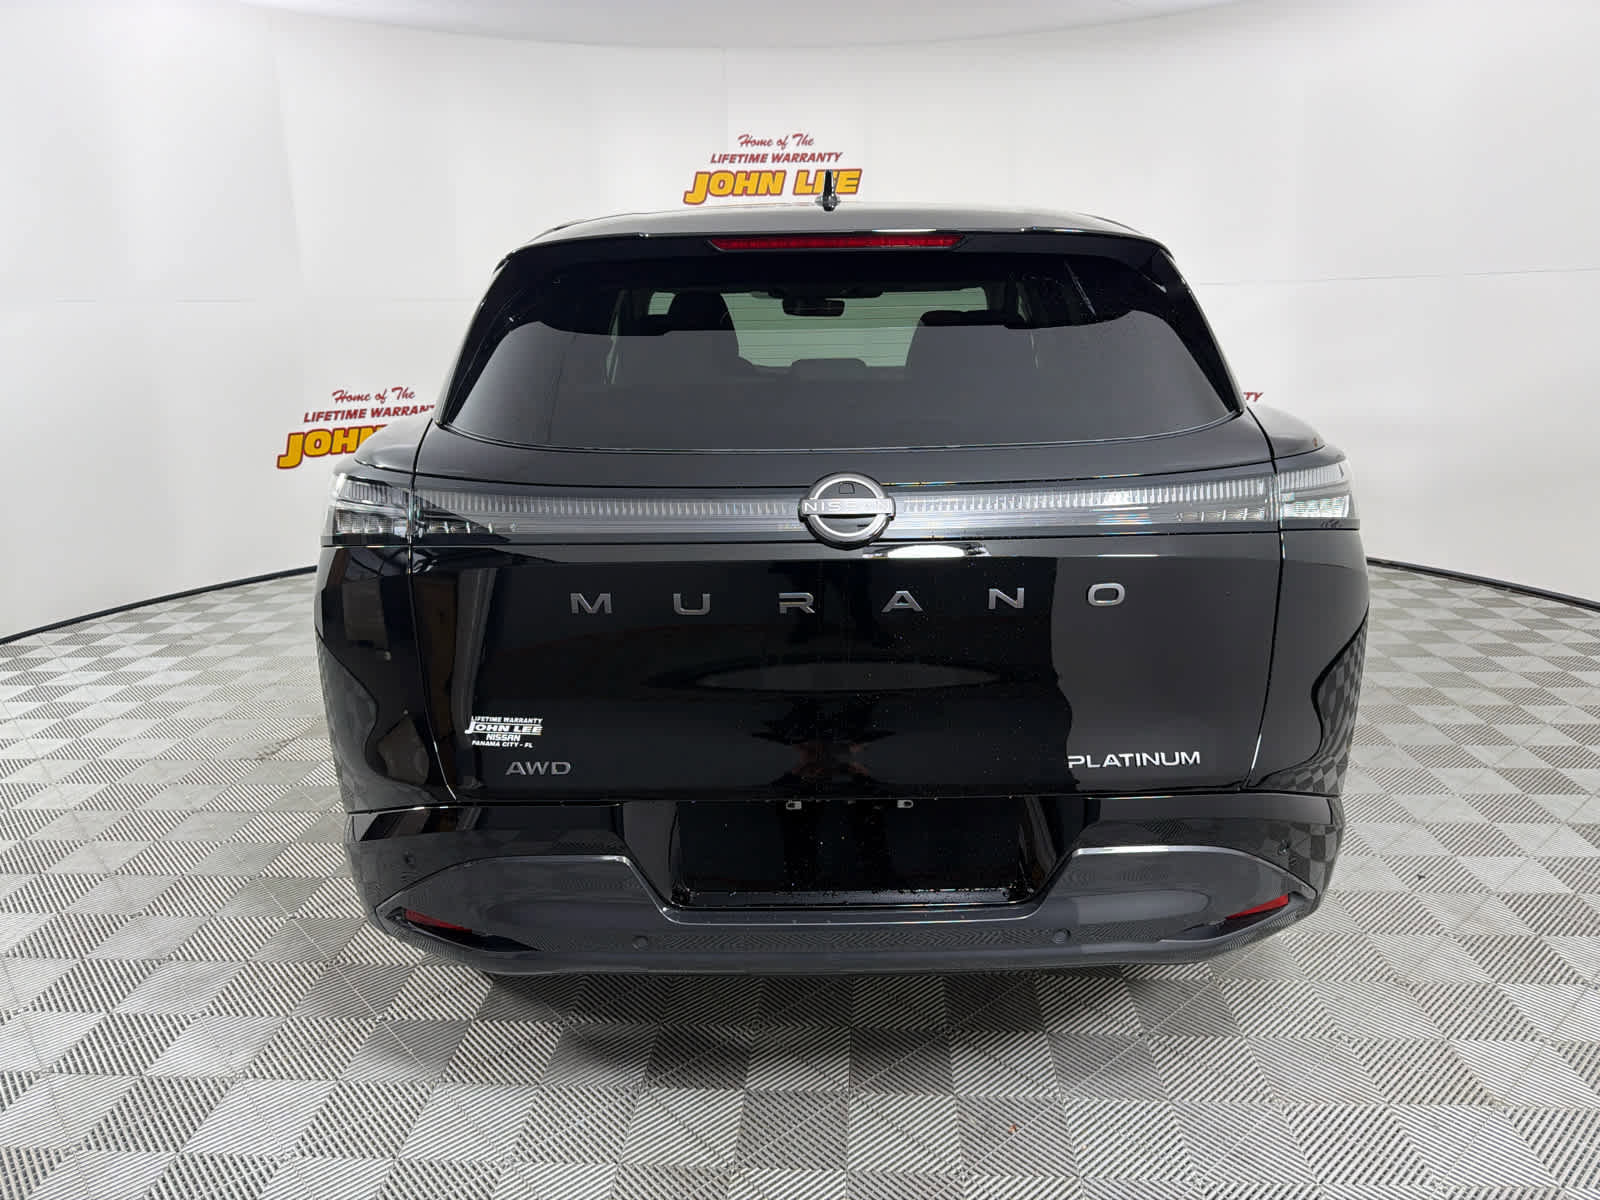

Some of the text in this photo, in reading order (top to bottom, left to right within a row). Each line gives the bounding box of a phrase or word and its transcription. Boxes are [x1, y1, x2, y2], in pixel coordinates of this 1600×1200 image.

[738, 133, 814, 150] Home of The
[710, 152, 843, 164] LIFETIME WARRANTY
[683, 170, 787, 205] JOHN
[332, 386, 415, 404] Home of The
[304, 405, 435, 423] LIFETIME WARRAN
[804, 501, 890, 513] NISSN
[570, 583, 1126, 616] MURANO
[464, 721, 543, 734] JOHN LEE
[486, 734, 521, 742] NISSAN
[505, 761, 571, 776] AWD
[1067, 751, 1200, 769] PLATINUM
